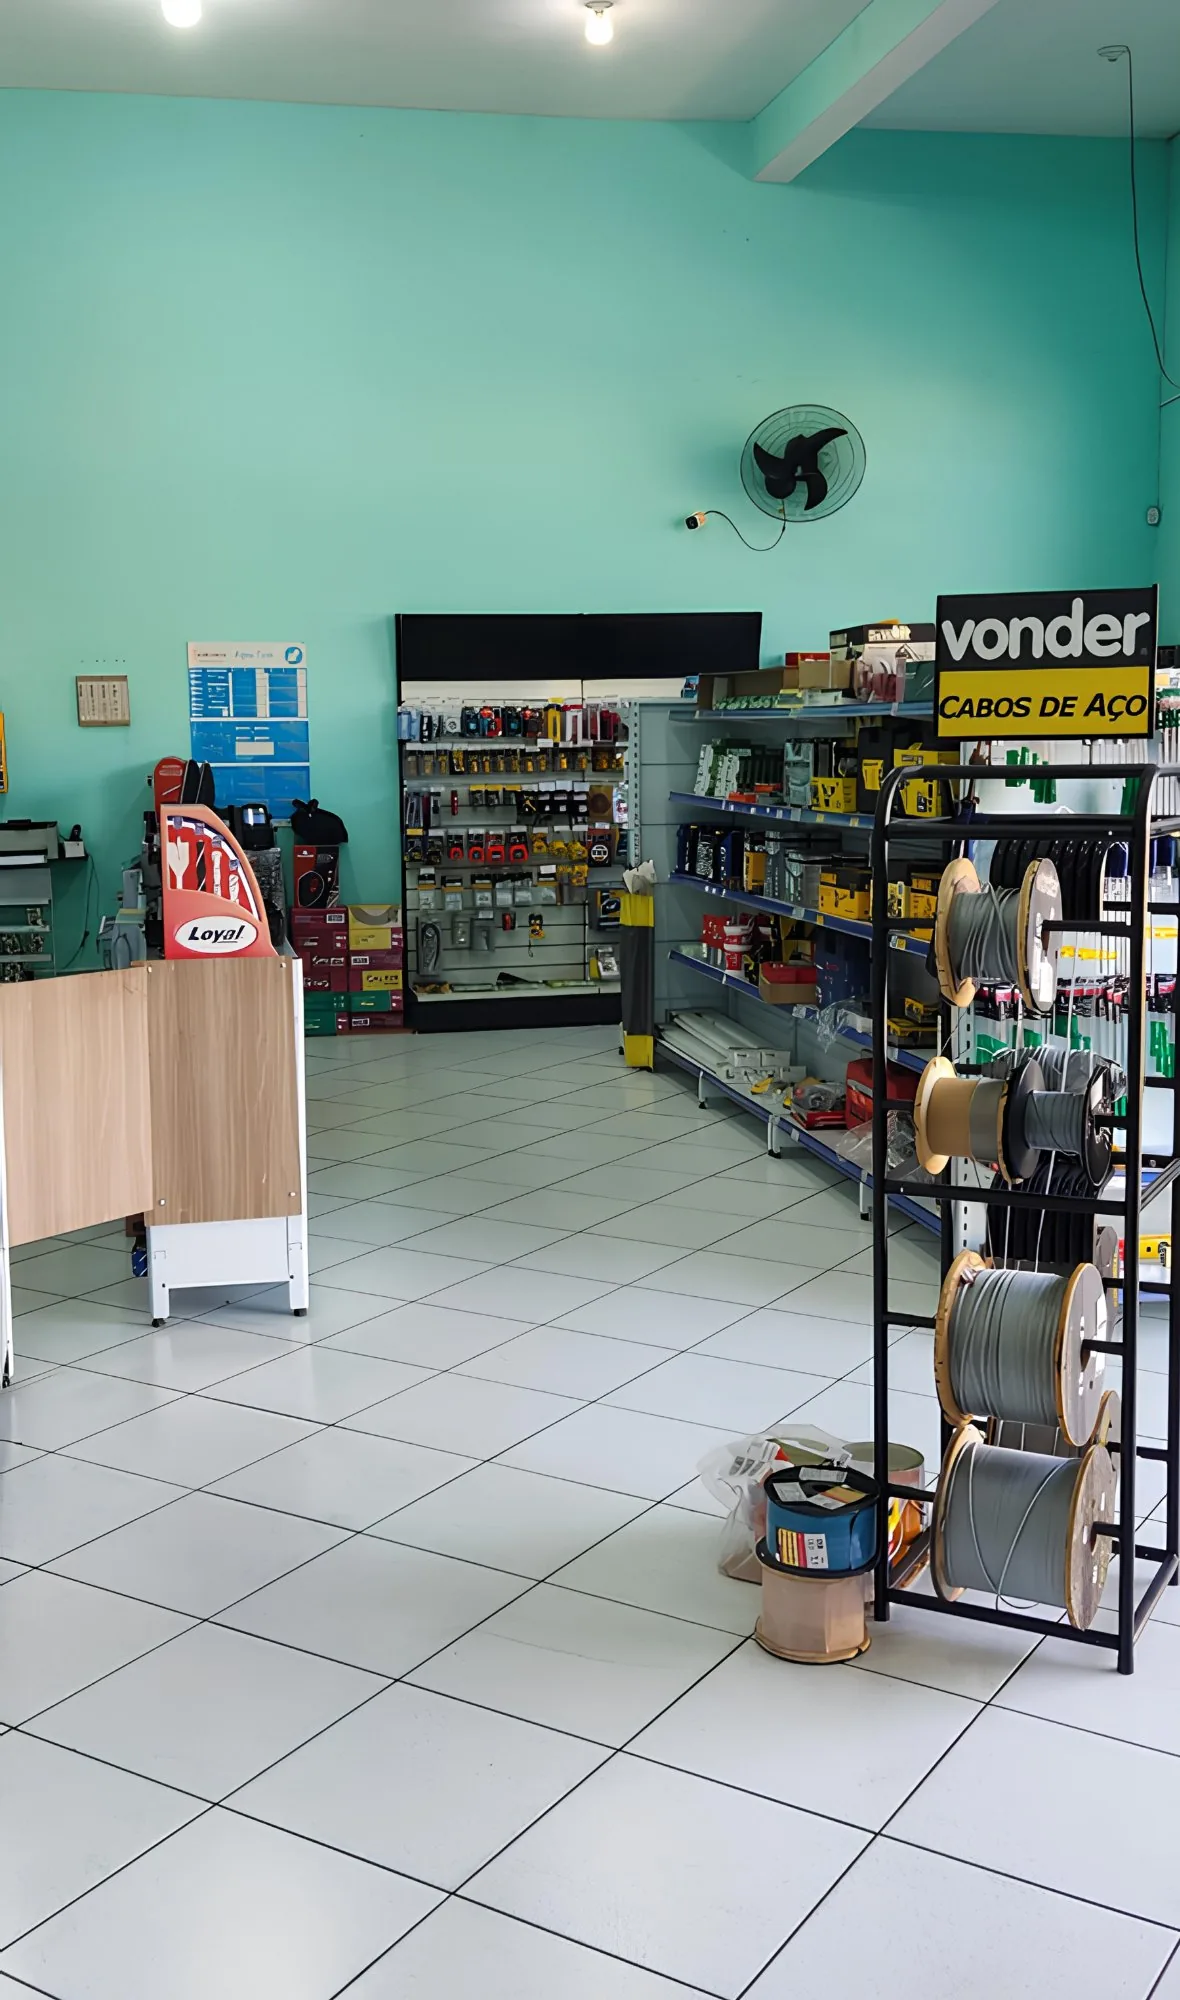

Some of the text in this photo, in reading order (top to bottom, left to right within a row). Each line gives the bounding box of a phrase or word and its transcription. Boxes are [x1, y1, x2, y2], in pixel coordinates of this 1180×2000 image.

[942, 598, 1150, 661] vonder
[939, 695, 1032, 719] CABOS
[1039, 696, 1078, 718] DE
[1083, 693, 1147, 722] AÇO
[188, 925, 245, 944] Loyal
